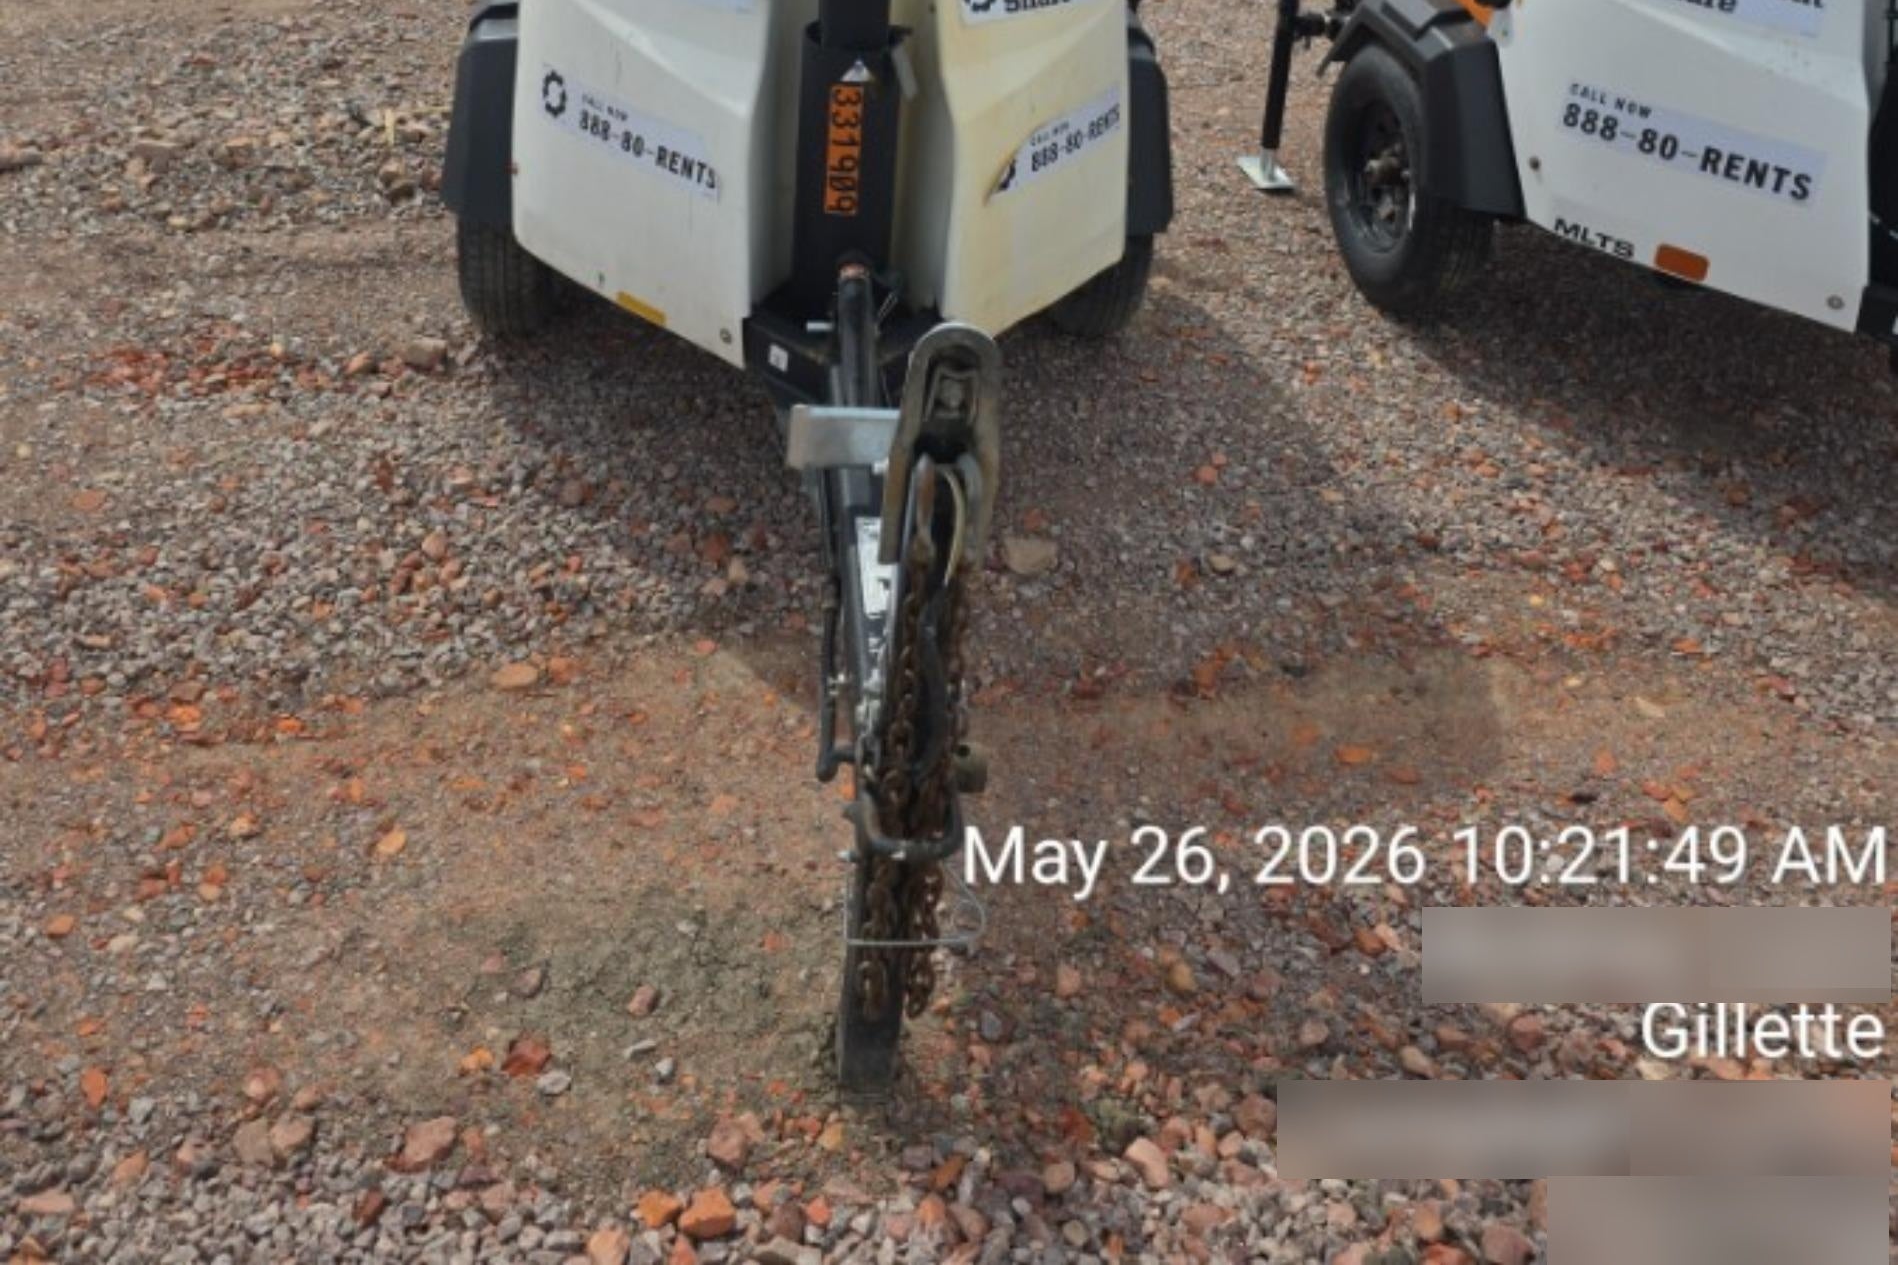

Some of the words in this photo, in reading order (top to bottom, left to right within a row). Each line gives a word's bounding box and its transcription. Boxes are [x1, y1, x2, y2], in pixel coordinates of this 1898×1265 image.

[1569, 83, 1607, 105] CALL
[1614, 97, 1652, 119] NOW
[579, 109, 717, 190] 888-80-RENTS
[826, 86, 862, 213] 331909
[1562, 102, 1813, 202] 888-80-RENTS
[1553, 217, 1636, 259] MLTS
